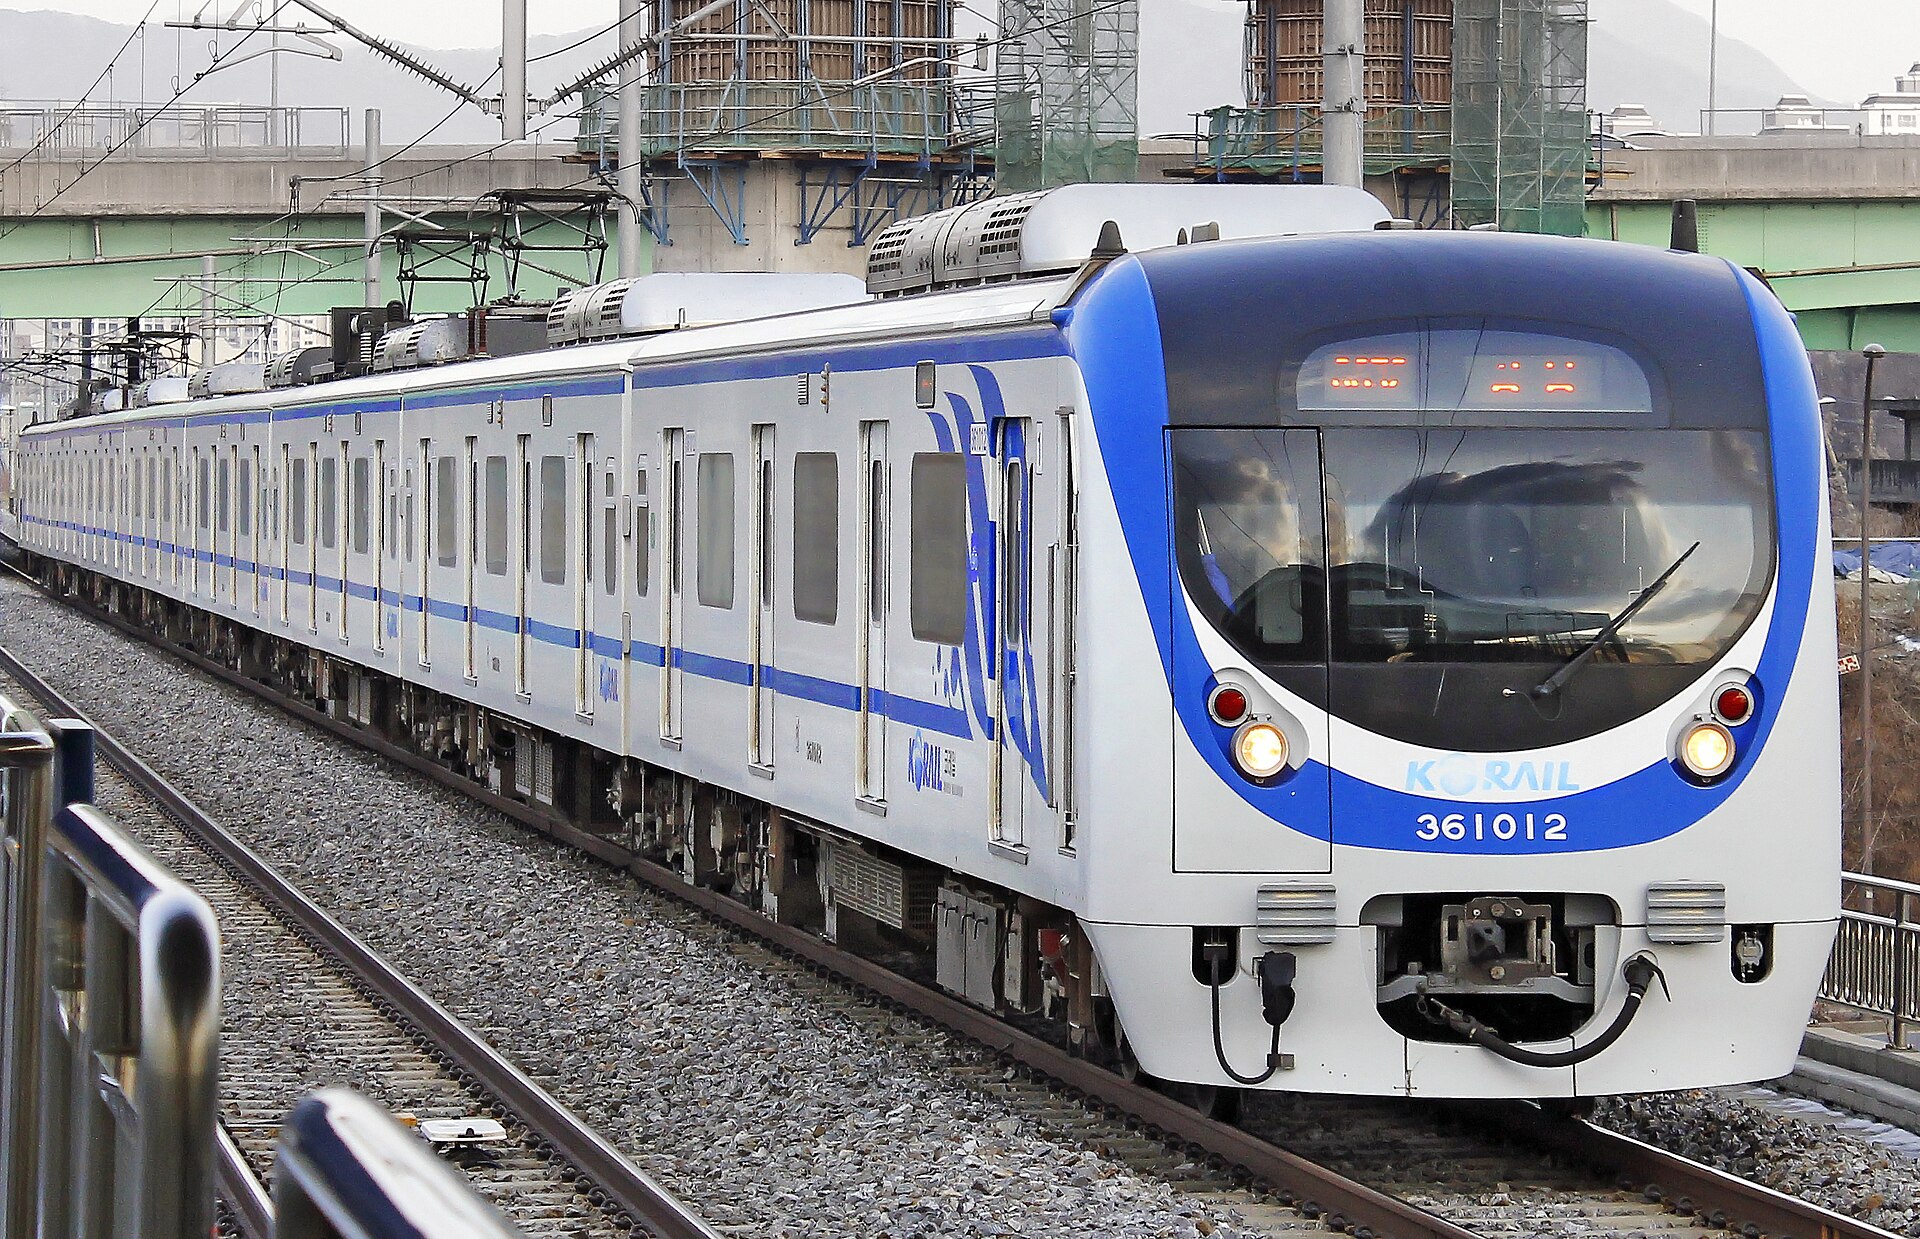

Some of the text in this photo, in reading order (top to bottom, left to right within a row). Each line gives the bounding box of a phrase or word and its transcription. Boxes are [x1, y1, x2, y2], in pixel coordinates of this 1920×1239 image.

[908, 728, 942, 792] KORAIL
[1405, 753, 1579, 796] KORAIL
[1415, 813, 1568, 841] 361012
